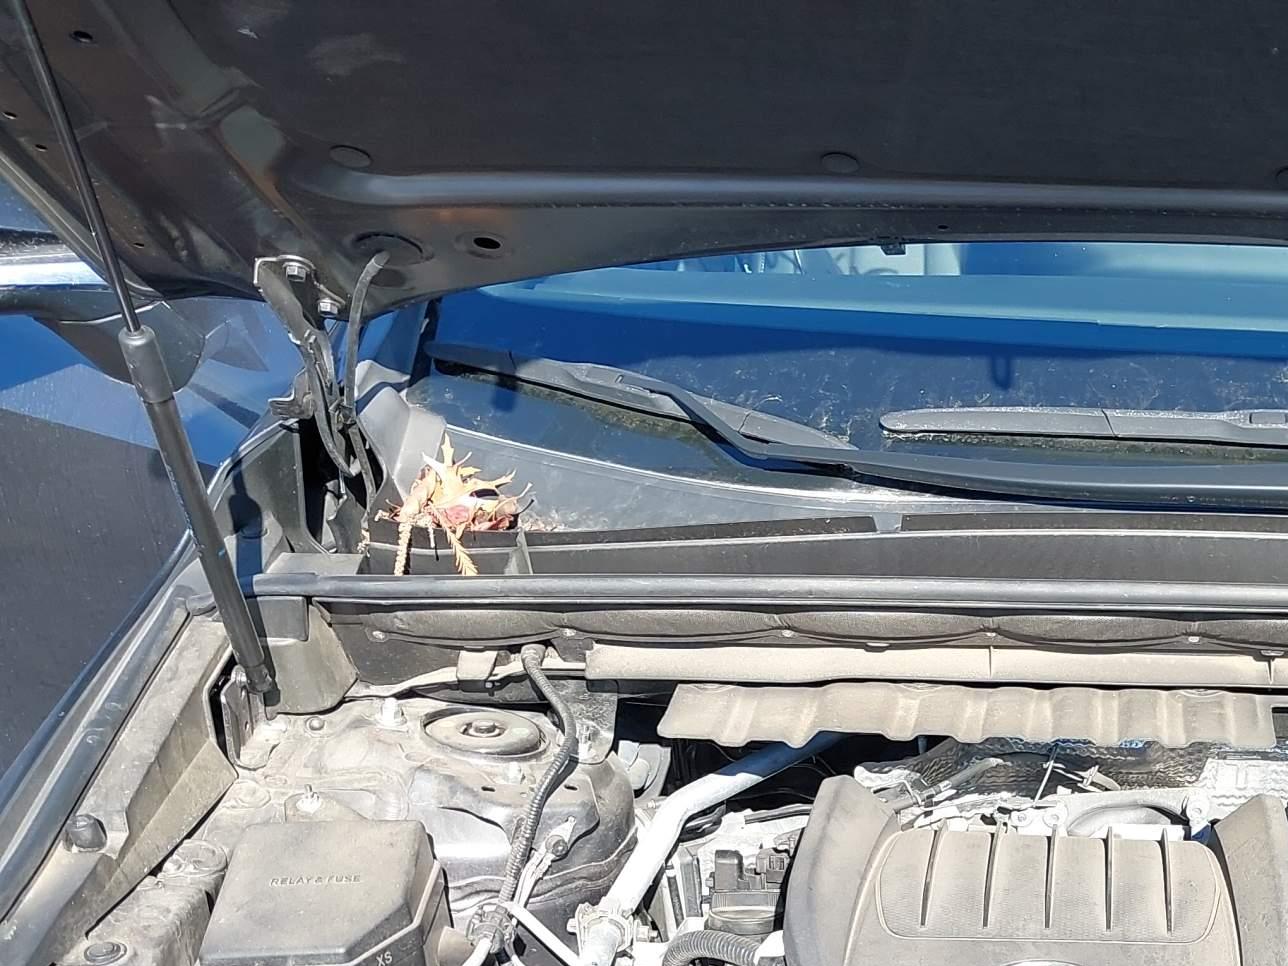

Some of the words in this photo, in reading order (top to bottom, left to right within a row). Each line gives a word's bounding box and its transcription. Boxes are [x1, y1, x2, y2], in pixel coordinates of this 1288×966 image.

[269, 876, 311, 887] RELAY
[314, 876, 323, 884] &
[327, 874, 361, 885] FUSE
